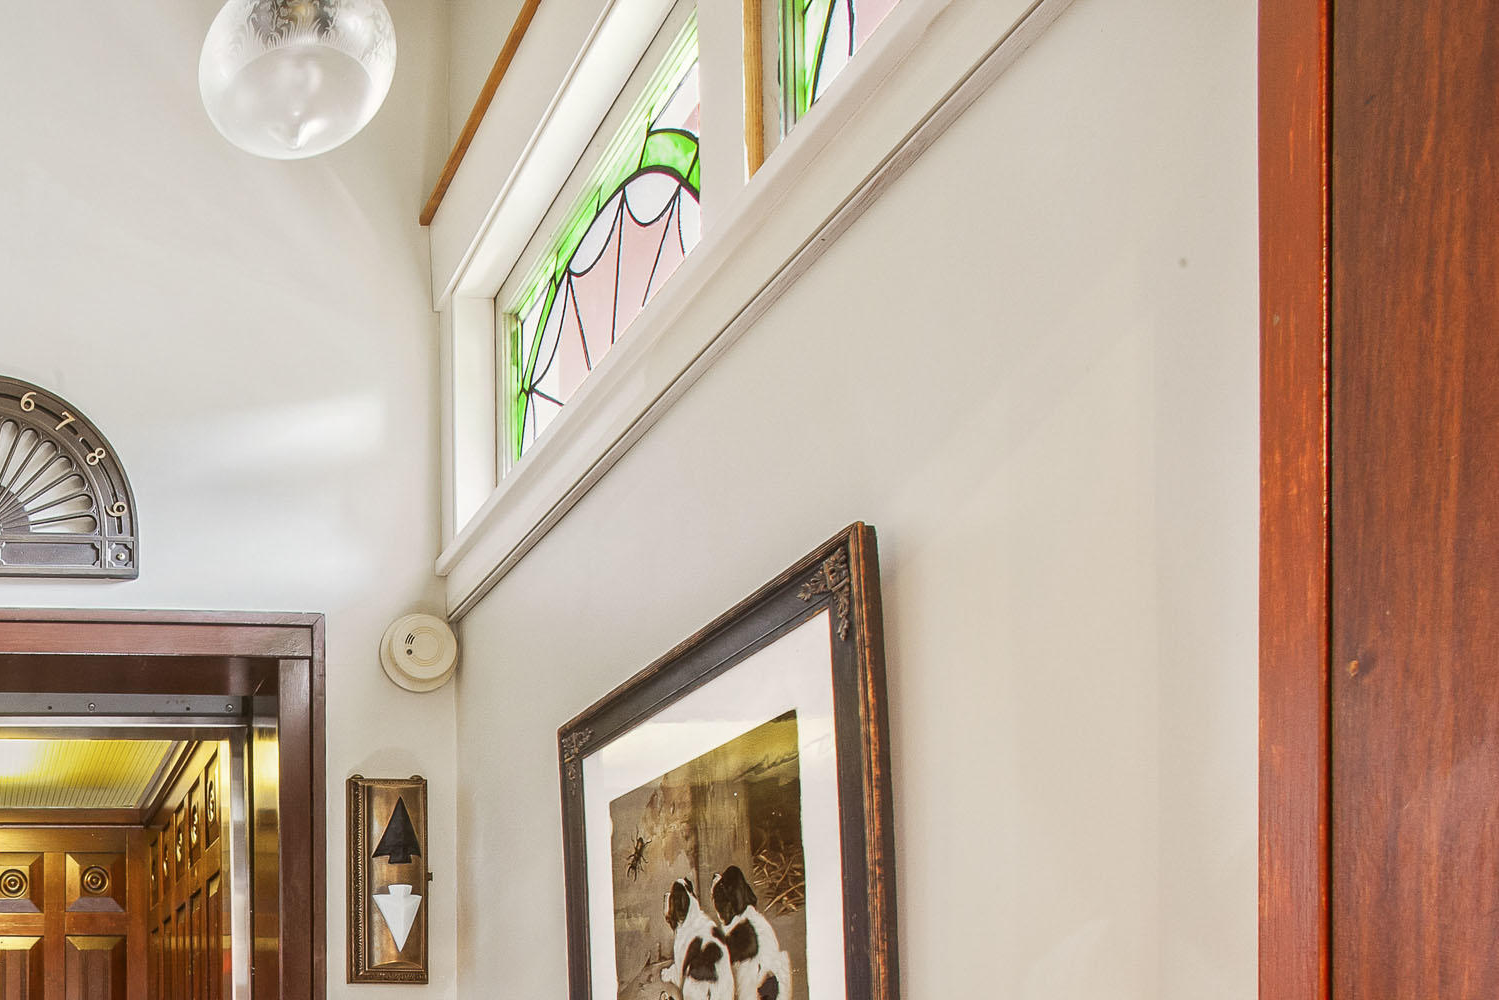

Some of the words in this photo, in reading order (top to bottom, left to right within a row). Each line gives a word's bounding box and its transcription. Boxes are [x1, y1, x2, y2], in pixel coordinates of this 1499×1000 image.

[20, 391, 37, 412] 6
[54, 411, 76, 432] 7
[85, 447, 106, 466] 8
[105, 501, 128, 518] 9
